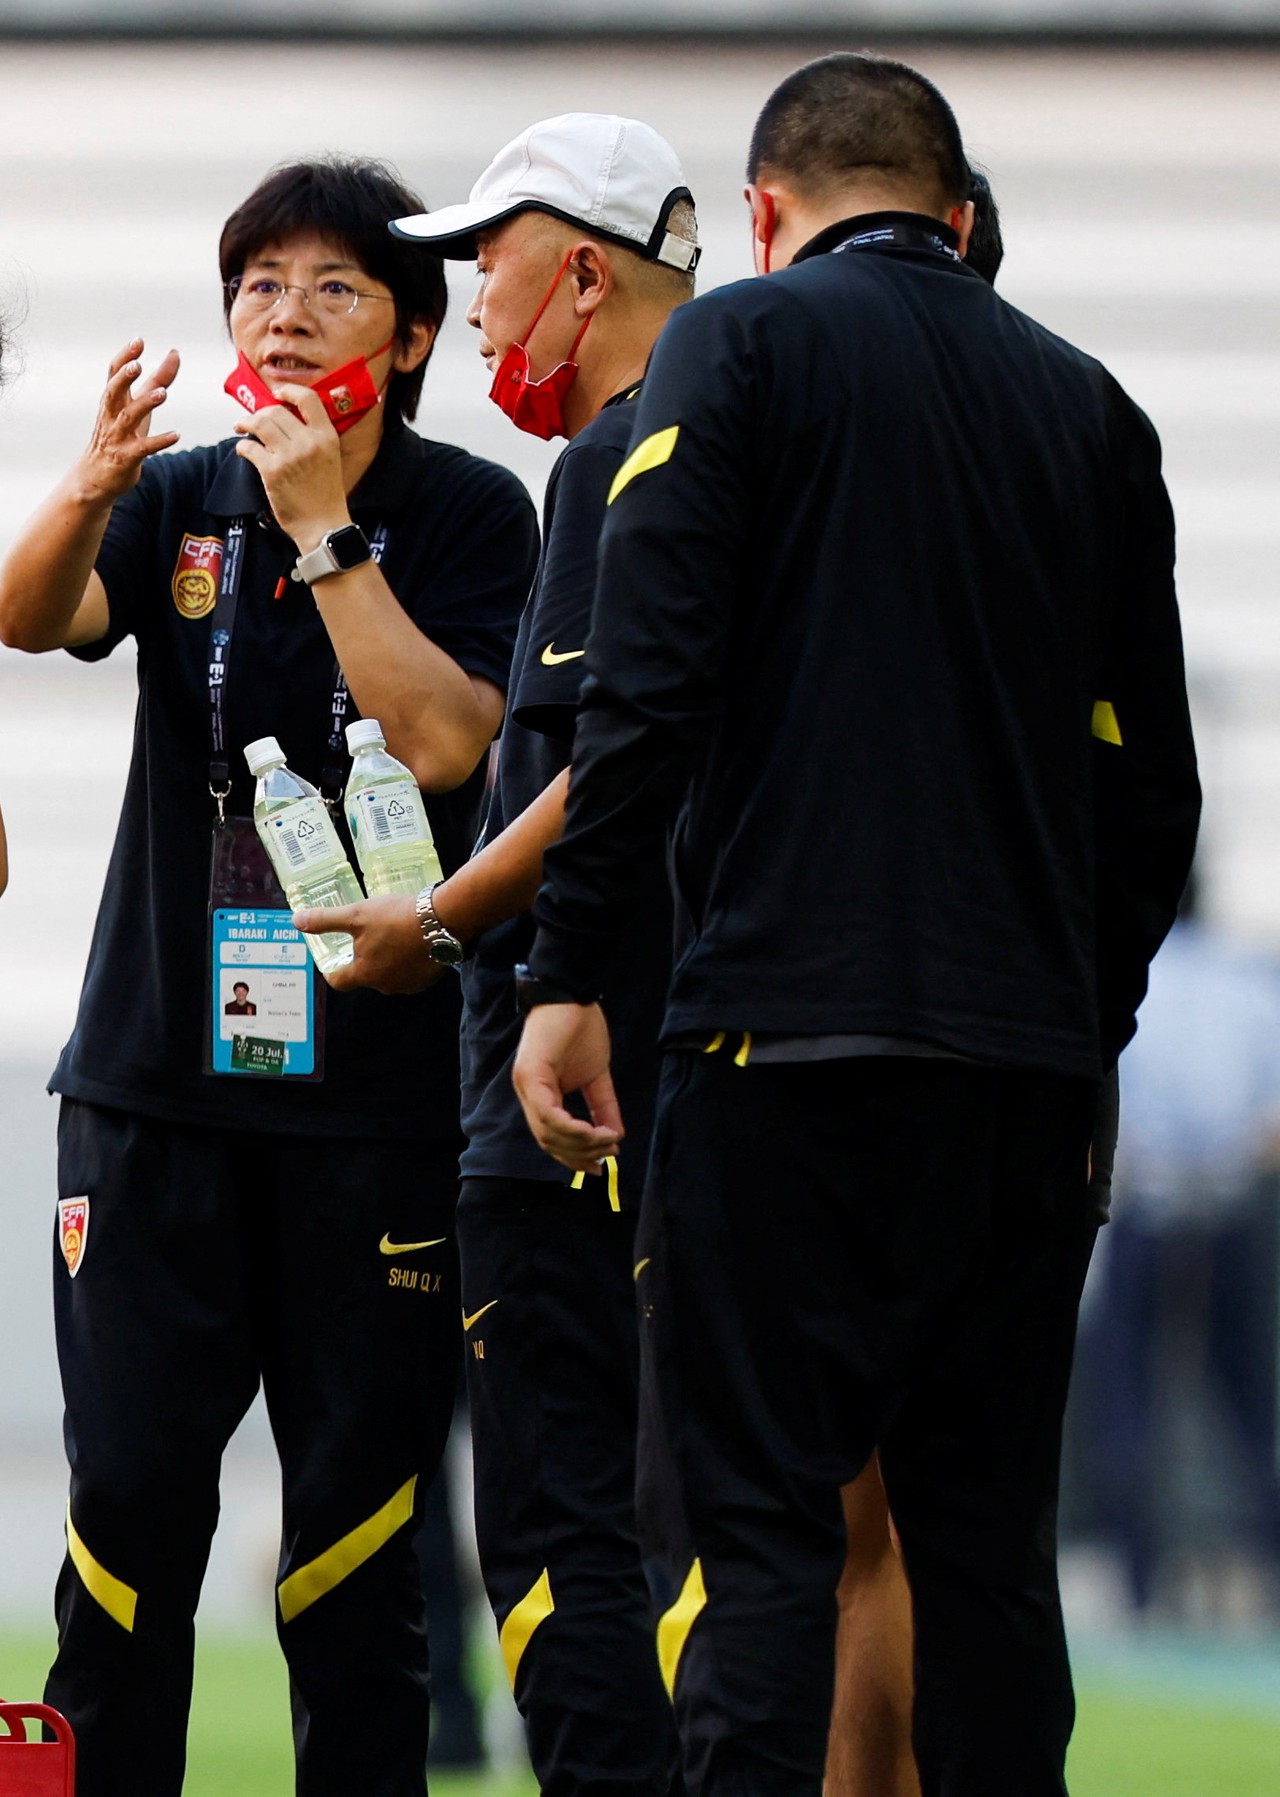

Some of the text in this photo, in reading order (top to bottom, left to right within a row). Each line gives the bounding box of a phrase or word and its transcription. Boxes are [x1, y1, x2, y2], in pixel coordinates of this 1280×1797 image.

[228, 928, 299, 940] IBARAKI AICHI
[251, 1045, 264, 1056] 20
[63, 1205, 85, 1222] CFA
[388, 1267, 442, 1293] SHUI Q X
